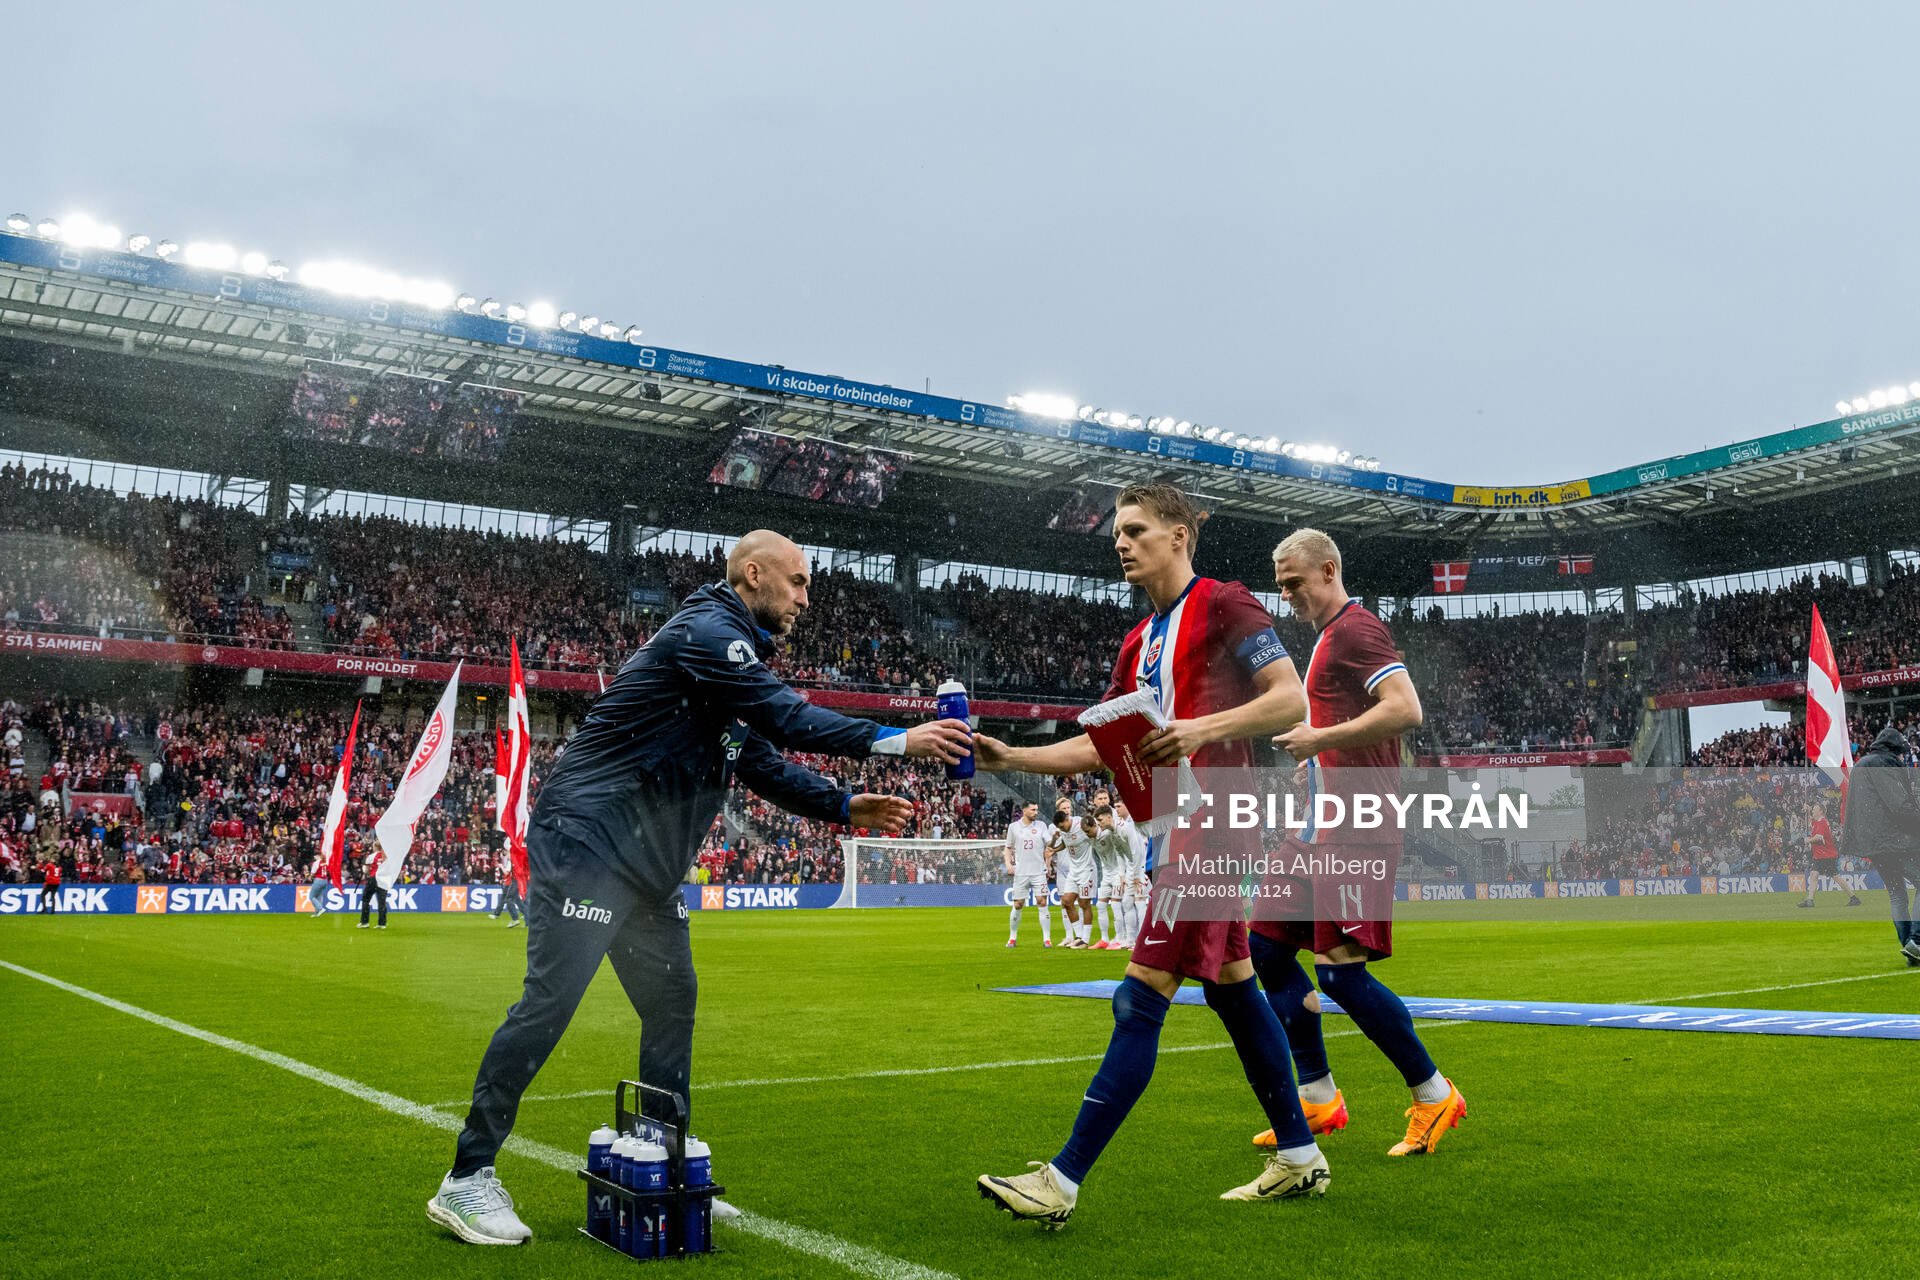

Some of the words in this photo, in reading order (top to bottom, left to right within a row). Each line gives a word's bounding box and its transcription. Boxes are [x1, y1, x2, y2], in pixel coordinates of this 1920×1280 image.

[766, 373, 780, 386] Vi
[783, 376, 831, 394] skaber
[833, 383, 913, 408] forbindelser
[1841, 409, 1903, 433] SAMMEN
[1732, 446, 1759, 460] GSV
[1640, 468, 1665, 481] GSV
[1494, 490, 1550, 504] hrh.dk
[6, 634, 33, 647] STÅ
[37, 637, 102, 652] SAMMEN
[337, 659, 363, 671] FOR
[365, 661, 417, 675] HOLDET
[1861, 674, 1880, 685] FOR
[1881, 673, 1892, 682] AT
[1893, 670, 1910, 681] STÅ
[889, 698, 908, 707] FOR
[909, 700, 923, 708] AT
[1489, 757, 1508, 765] FOR
[1509, 755, 1547, 765] HOLDET
[1023, 839, 1034, 850] 23
[1081, 886, 1089, 897] 18
[1422, 884, 1466, 901] STARK
[1488, 883, 1534, 899] STARK
[1559, 881, 1608, 898] STARK
[1635, 878, 1688, 896] STARK
[1718, 876, 1775, 894] STARK
[0, 887, 110, 913] STARK
[169, 887, 270, 912] STARK
[725, 887, 799, 908] STARK
[1337, 884, 1364, 920] 14
[562, 897, 613, 924] bama
[1151, 887, 1182, 934] 10
[650, 1174, 662, 1182] YT
